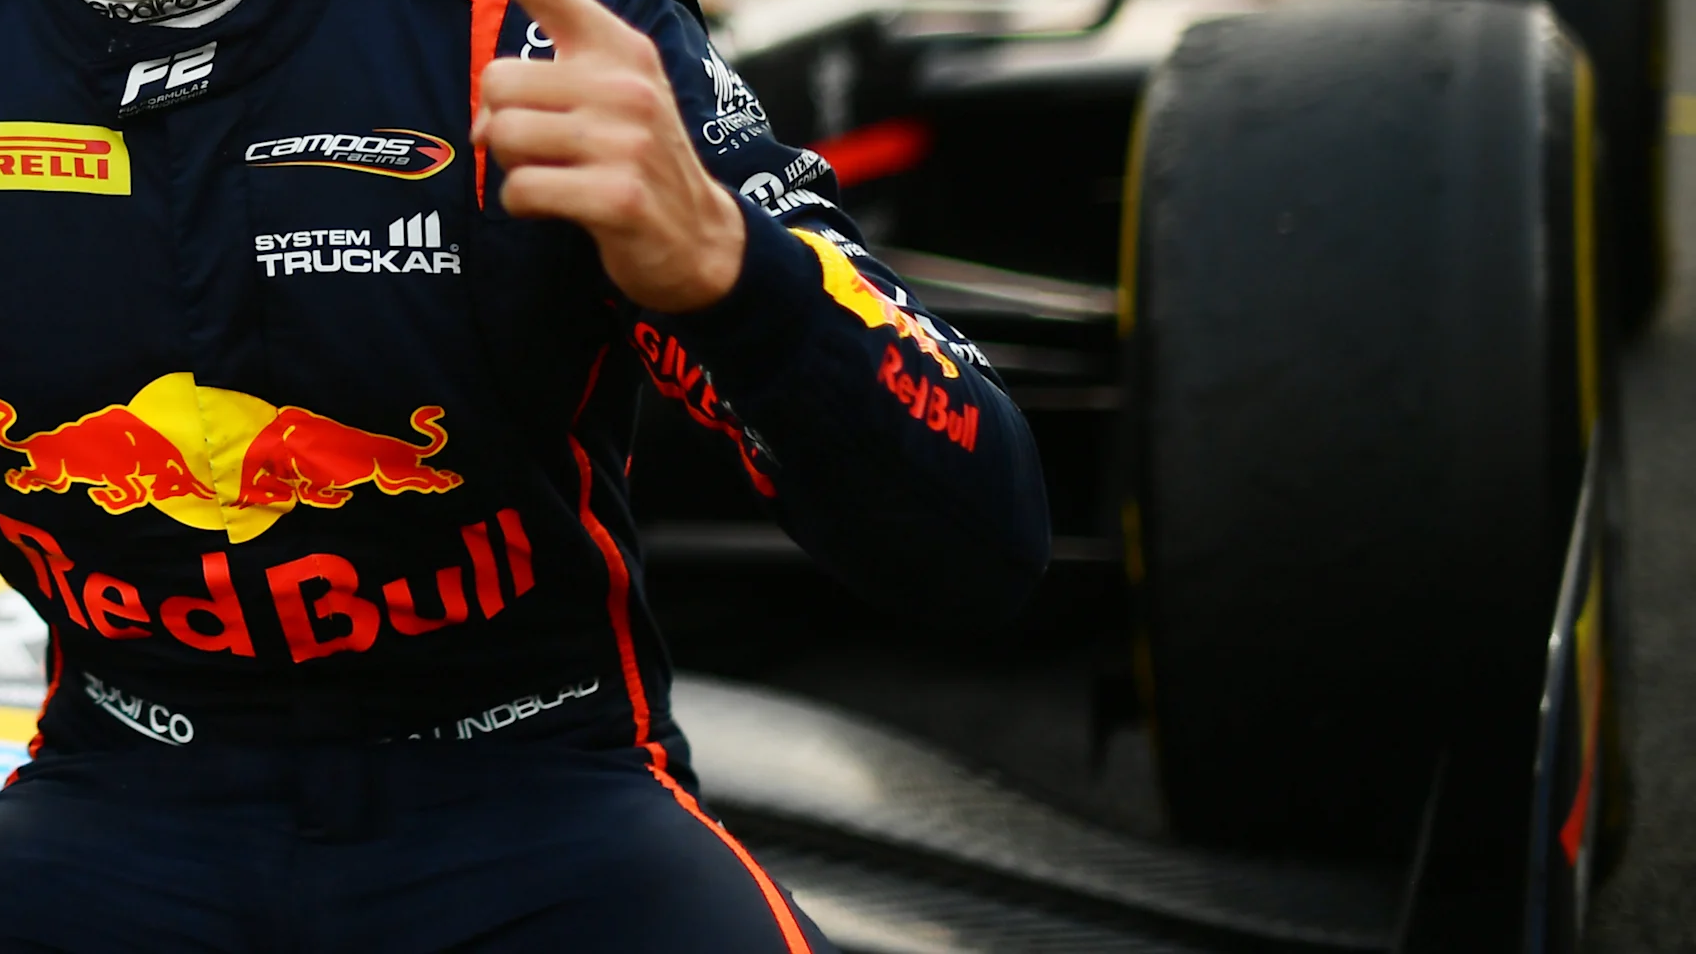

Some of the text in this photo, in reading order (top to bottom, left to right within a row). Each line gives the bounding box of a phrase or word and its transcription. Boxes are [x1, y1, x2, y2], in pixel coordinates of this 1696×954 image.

[120, 40, 218, 106] F2
[200, 79, 210, 90] 2
[245, 133, 416, 162] campos
[331, 151, 411, 166] racing
[255, 229, 371, 252] SYSTEM
[256, 249, 462, 278] TRUCKAR
[926, 386, 980, 453] Bull
[265, 508, 536, 664] Bull
[434, 676, 600, 741] INDBLAD
